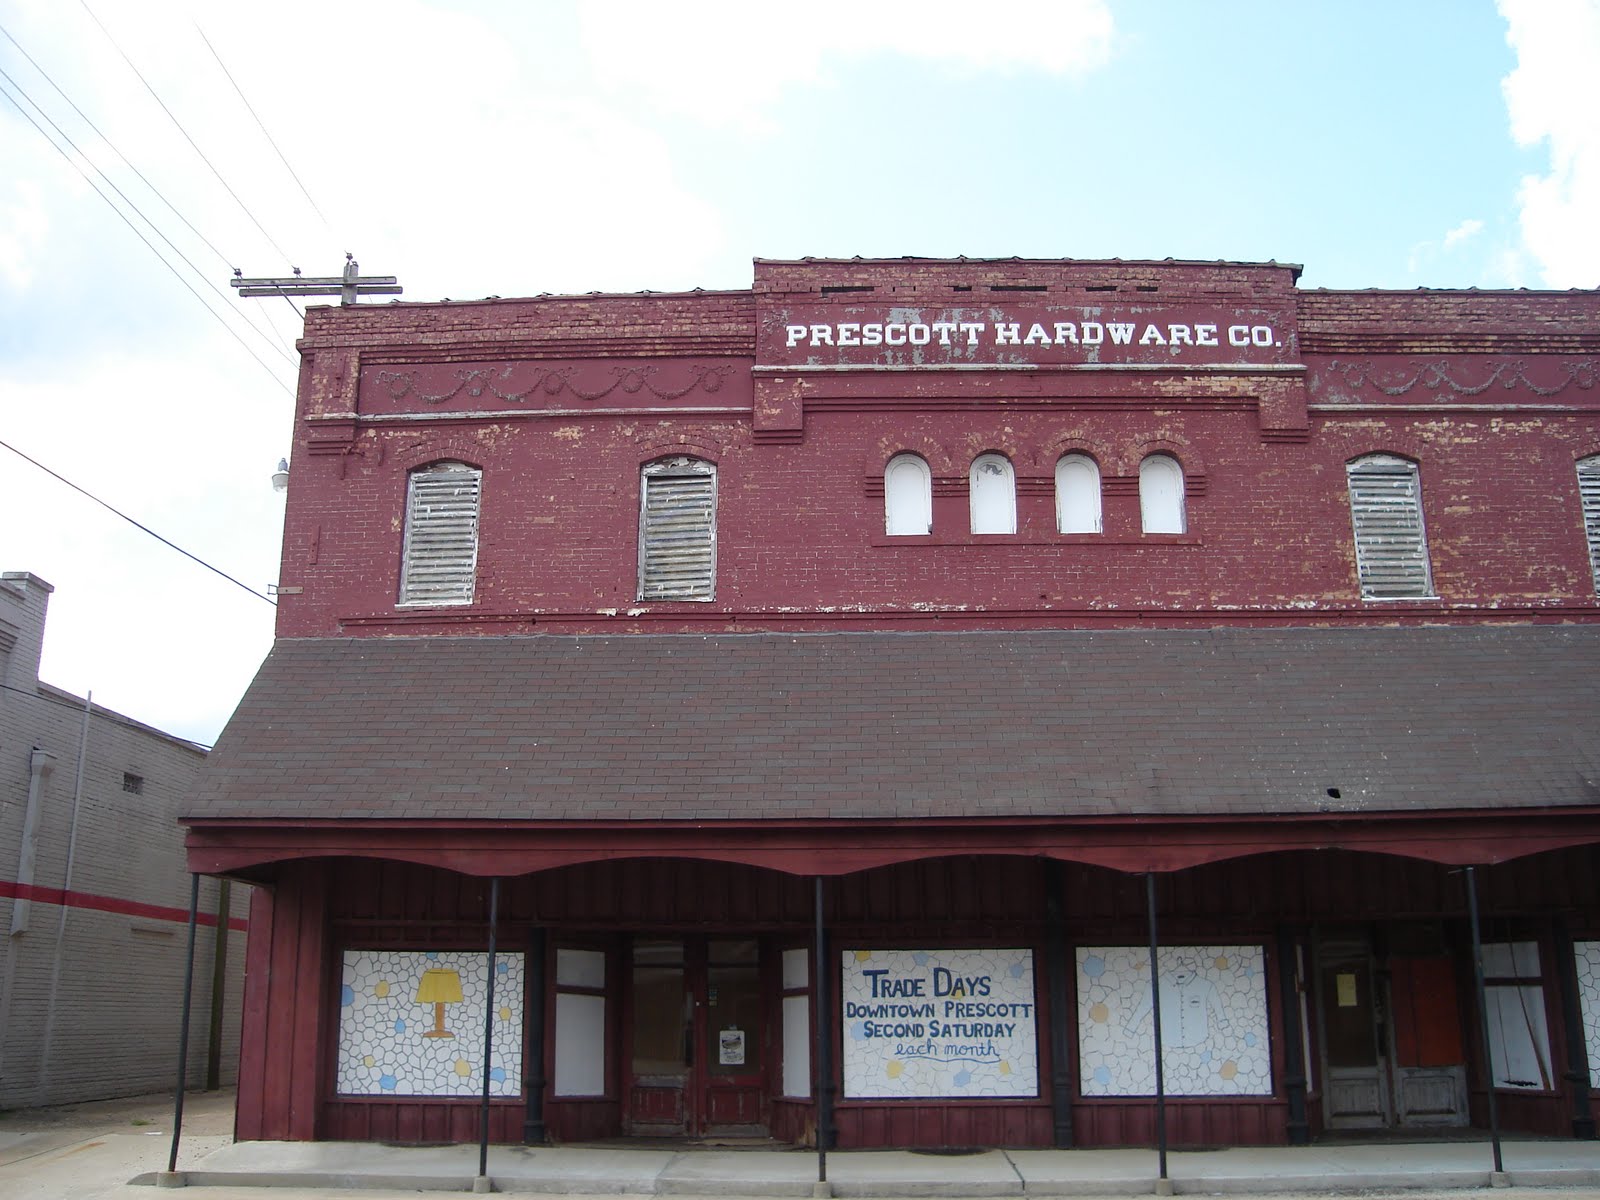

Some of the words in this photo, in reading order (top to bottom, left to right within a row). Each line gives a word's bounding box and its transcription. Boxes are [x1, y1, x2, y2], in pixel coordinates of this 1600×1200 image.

[785, 322, 985, 348] PRESCOTT
[995, 322, 1219, 347] HARDWARE
[1227, 324, 1282, 348] CO.
[862, 969, 926, 998] TRADE
[933, 967, 992, 997] DAYS
[846, 1001, 935, 1018] DOWNTOWN
[944, 1001, 1033, 1018] PRESCOTT
[863, 1020, 925, 1038] SECOND
[928, 1020, 1017, 1038] SATURDAY
[894, 1038, 938, 1056] each
[943, 1039, 1001, 1057] month
